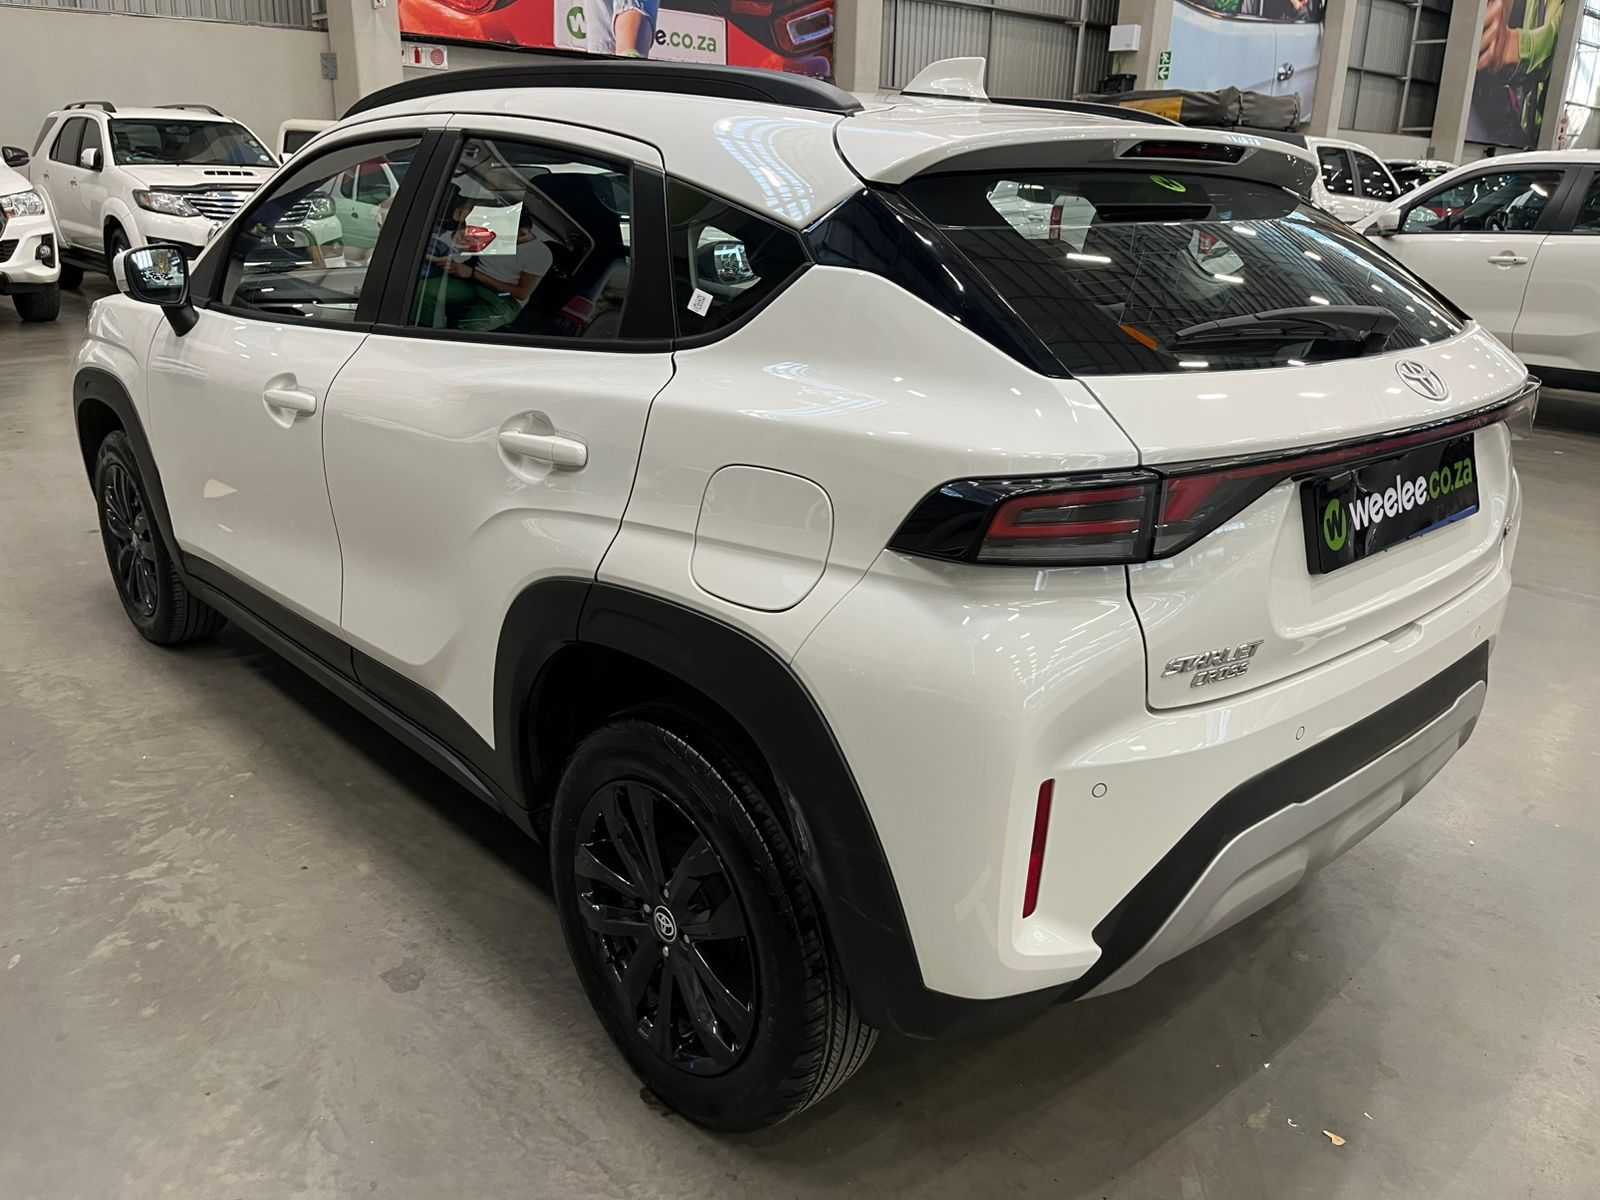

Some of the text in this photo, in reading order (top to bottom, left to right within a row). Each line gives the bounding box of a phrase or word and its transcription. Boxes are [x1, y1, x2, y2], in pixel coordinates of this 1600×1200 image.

[655, 29, 716, 52] e.co.za
[1349, 457, 1473, 531] weelee.co.za
[1161, 640, 1264, 678] STARLET
[1190, 660, 1250, 688] CROSS
